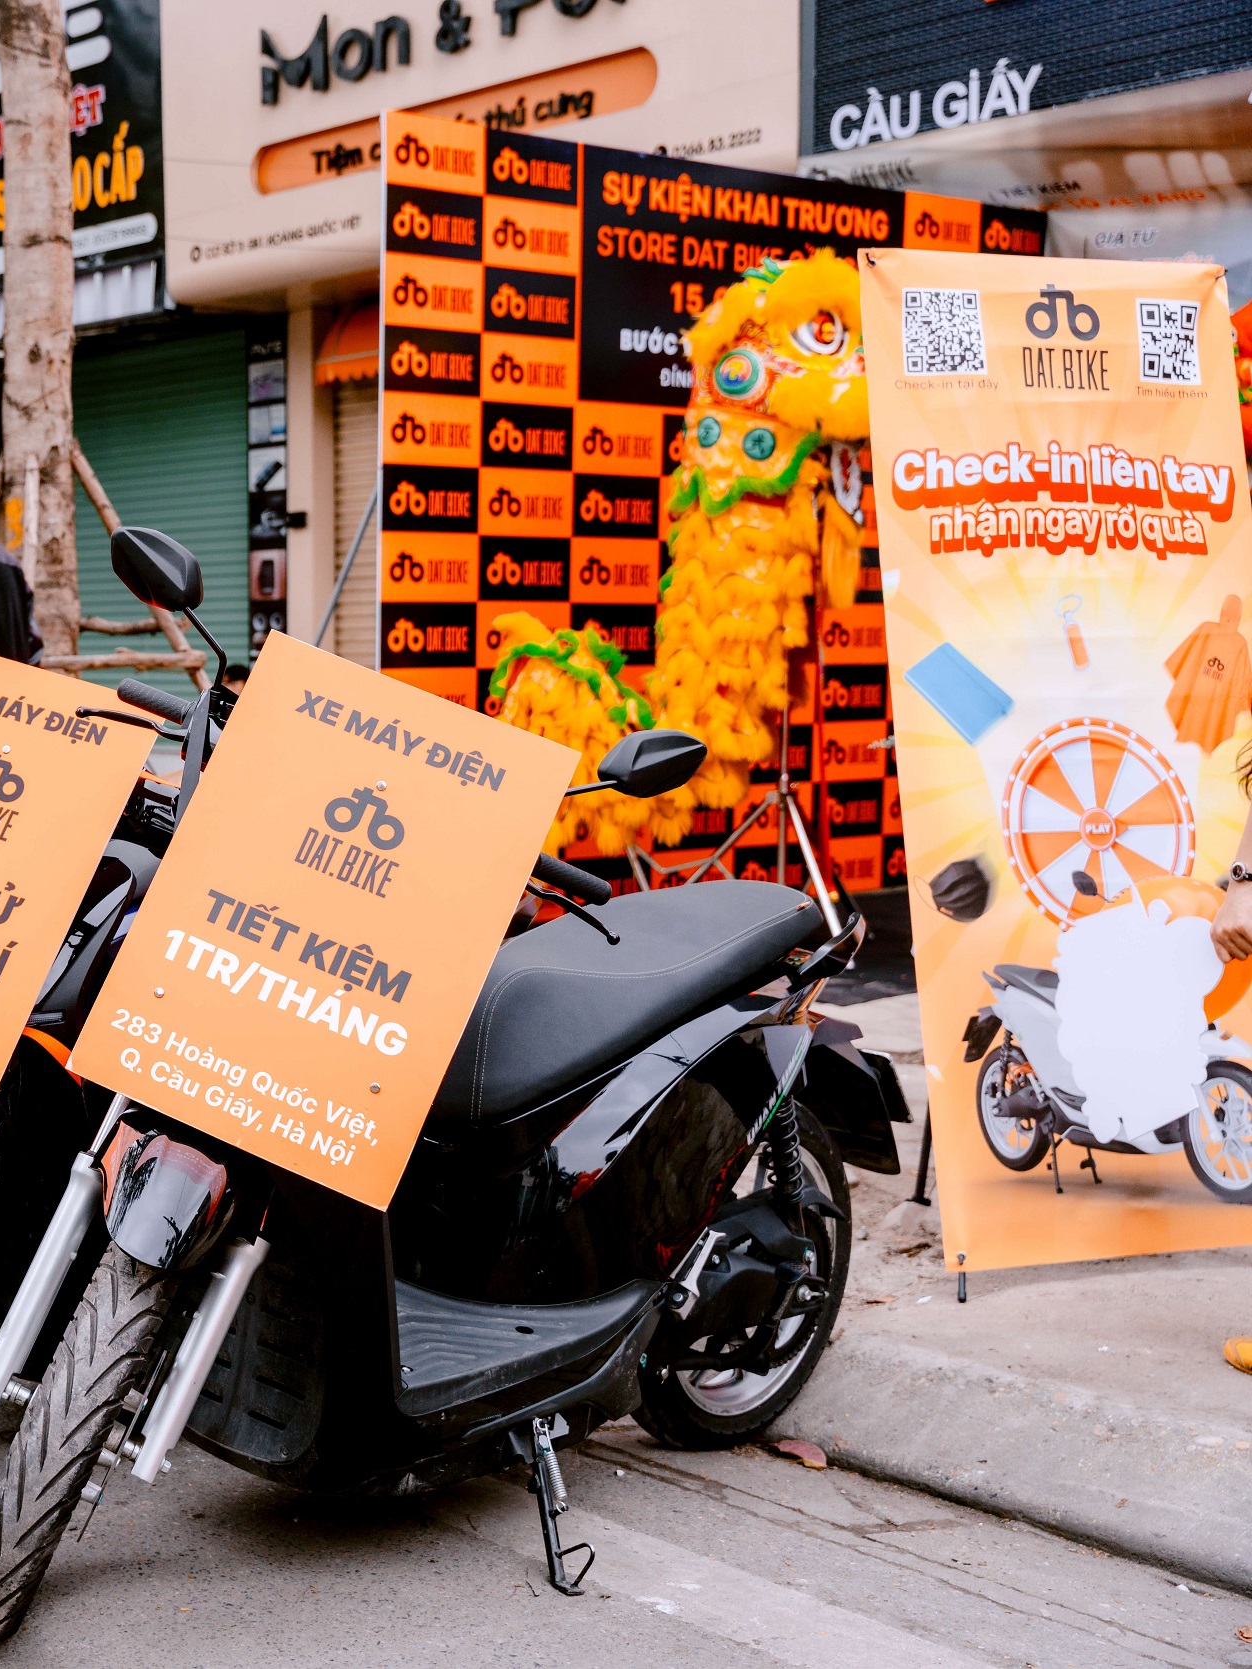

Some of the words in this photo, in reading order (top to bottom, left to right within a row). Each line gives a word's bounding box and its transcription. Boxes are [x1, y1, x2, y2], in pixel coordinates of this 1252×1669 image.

[260, 13, 412, 107] Mon
[435, 0, 472, 54] &
[830, 86, 922, 151] CẦU
[932, 57, 1044, 130] GIẤY
[93, 120, 145, 209] CẤP
[602, 171, 646, 215] SỰ
[649, 173, 712, 223] KIỆN
[714, 186, 780, 227] KHAI
[782, 196, 890, 241] TRƯƠNG
[597, 226, 677, 264] STORE
[682, 233, 729, 270] DAT
[619, 325, 679, 356] BƯỚC
[1023, 346, 1110, 391] DAT.BIKE
[893, 441, 1088, 494] Check-in
[1089, 446, 1159, 494] liền
[1162, 456, 1233, 505] tay
[931, 504, 1020, 547] nhận
[1026, 509, 1102, 547] ngay
[1142, 512, 1205, 554] quà
[42, 712, 108, 747] ĐIỆN
[296, 690, 340, 727] XE
[344, 709, 428, 757] MÁY
[426, 745, 507, 793] ĐIỆN
[294, 827, 400, 899] DAT.BIKE
[1085, 823, 1112, 836] PLAY
[207, 888, 301, 955] TIẾT
[298, 942, 413, 1004] KIỆM
[164, 929, 409, 1057] 1TR/THÁNG
[110, 1008, 164, 1046] 283
[164, 1030, 248, 1089] Hoàng
[251, 1069, 318, 1115] Quốc
[325, 1101, 379, 1148] Việt,
[119, 1047, 142, 1077] Q.
[149, 1058, 202, 1097] Cầu
[204, 1085, 264, 1133] Giấy,
[270, 1111, 309, 1146] Hà
[308, 1131, 356, 1168] Nội
